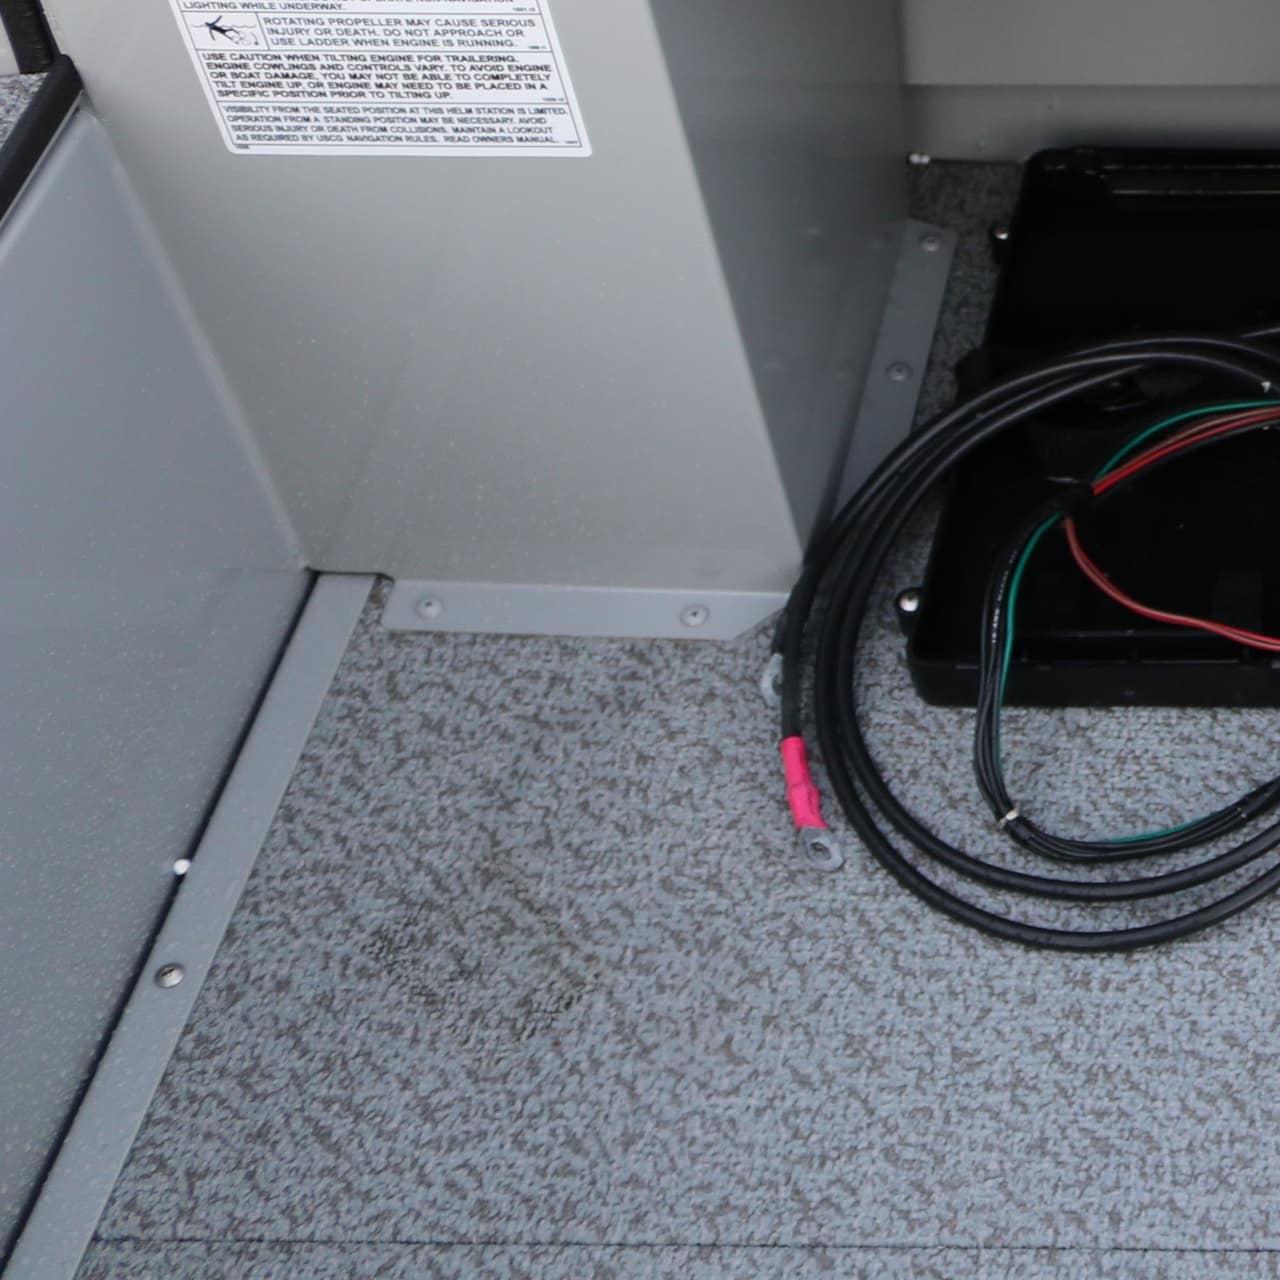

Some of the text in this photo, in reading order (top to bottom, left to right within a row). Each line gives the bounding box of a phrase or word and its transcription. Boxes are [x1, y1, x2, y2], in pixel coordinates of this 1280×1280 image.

[182, 1, 238, 10] LIGHTING
[239, 2, 277, 10] WHILE
[262, 17, 536, 28] ROTATING PROPELLER MAY CAUSE SERIOUS
[266, 27, 310, 36] INJURY
[313, 27, 333, 36] OR
[382, 28, 402, 37] DO
[404, 28, 429, 37] NOT
[433, 28, 503, 37] APPROACH
[505, 29, 525, 38] OR
[270, 37, 297, 46] USE
[298, 37, 350, 46] LADDER
[351, 38, 390, 47] WHEN
[392, 38, 440, 47] ENGINE
[441, 39, 455, 47] IS
